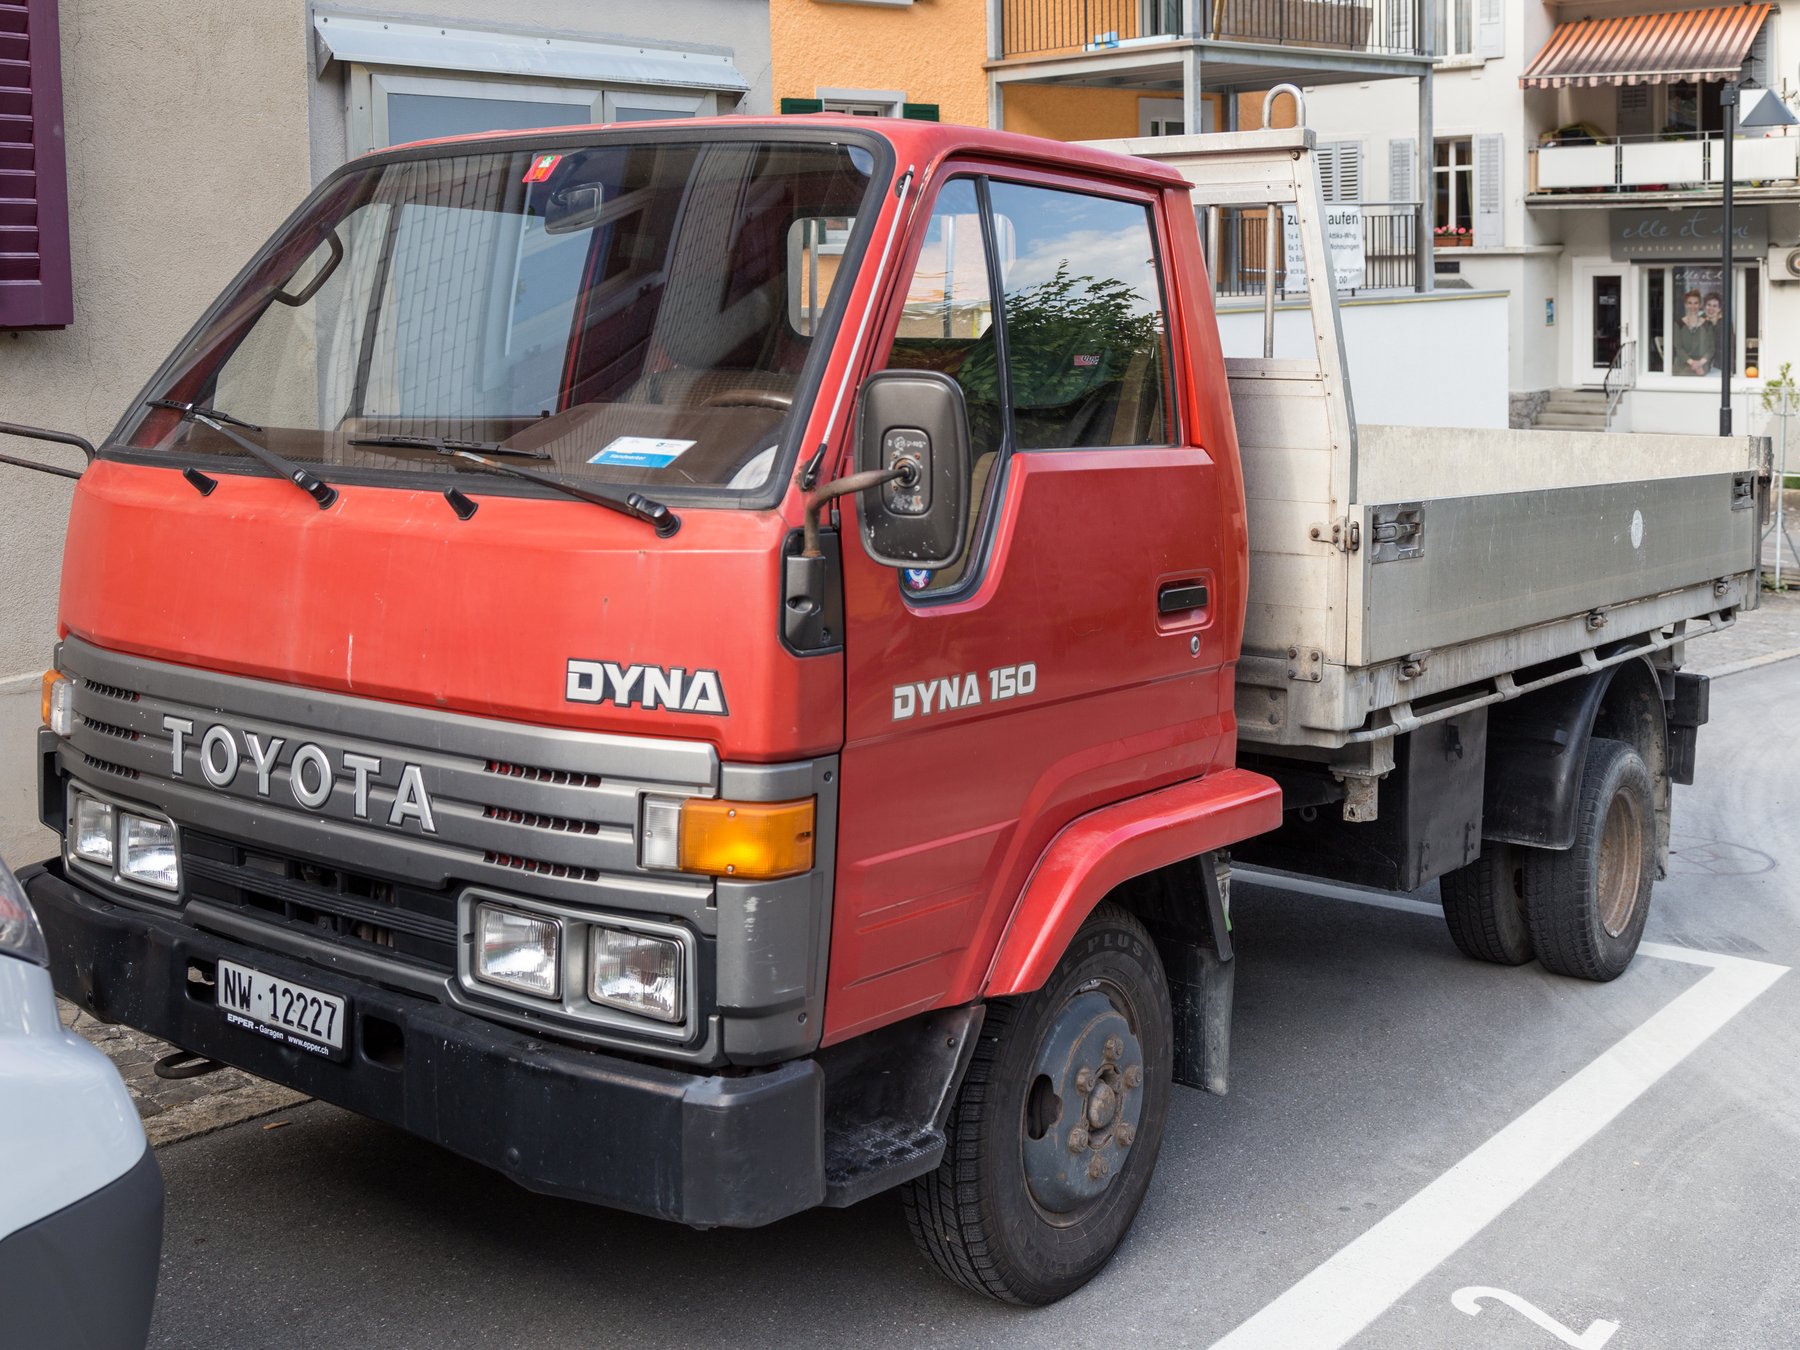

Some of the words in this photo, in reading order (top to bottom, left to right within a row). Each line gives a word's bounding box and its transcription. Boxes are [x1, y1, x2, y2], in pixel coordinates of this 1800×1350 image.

[1622, 219, 1670, 239] elle
[1680, 209, 1707, 238] et
[566, 658, 728, 716] DYNA
[893, 672, 982, 720] DYNA
[988, 662, 1037, 701] 150
[163, 714, 438, 835] TOYOTA
[224, 967, 253, 1012] NW
[268, 983, 338, 1041] 12227
[227, 1013, 254, 1030] EPPER
[259, 1024, 284, 1040] Garagen
[287, 1034, 329, 1056] www.epper.ch
[1451, 1286, 1620, 1350] 2
